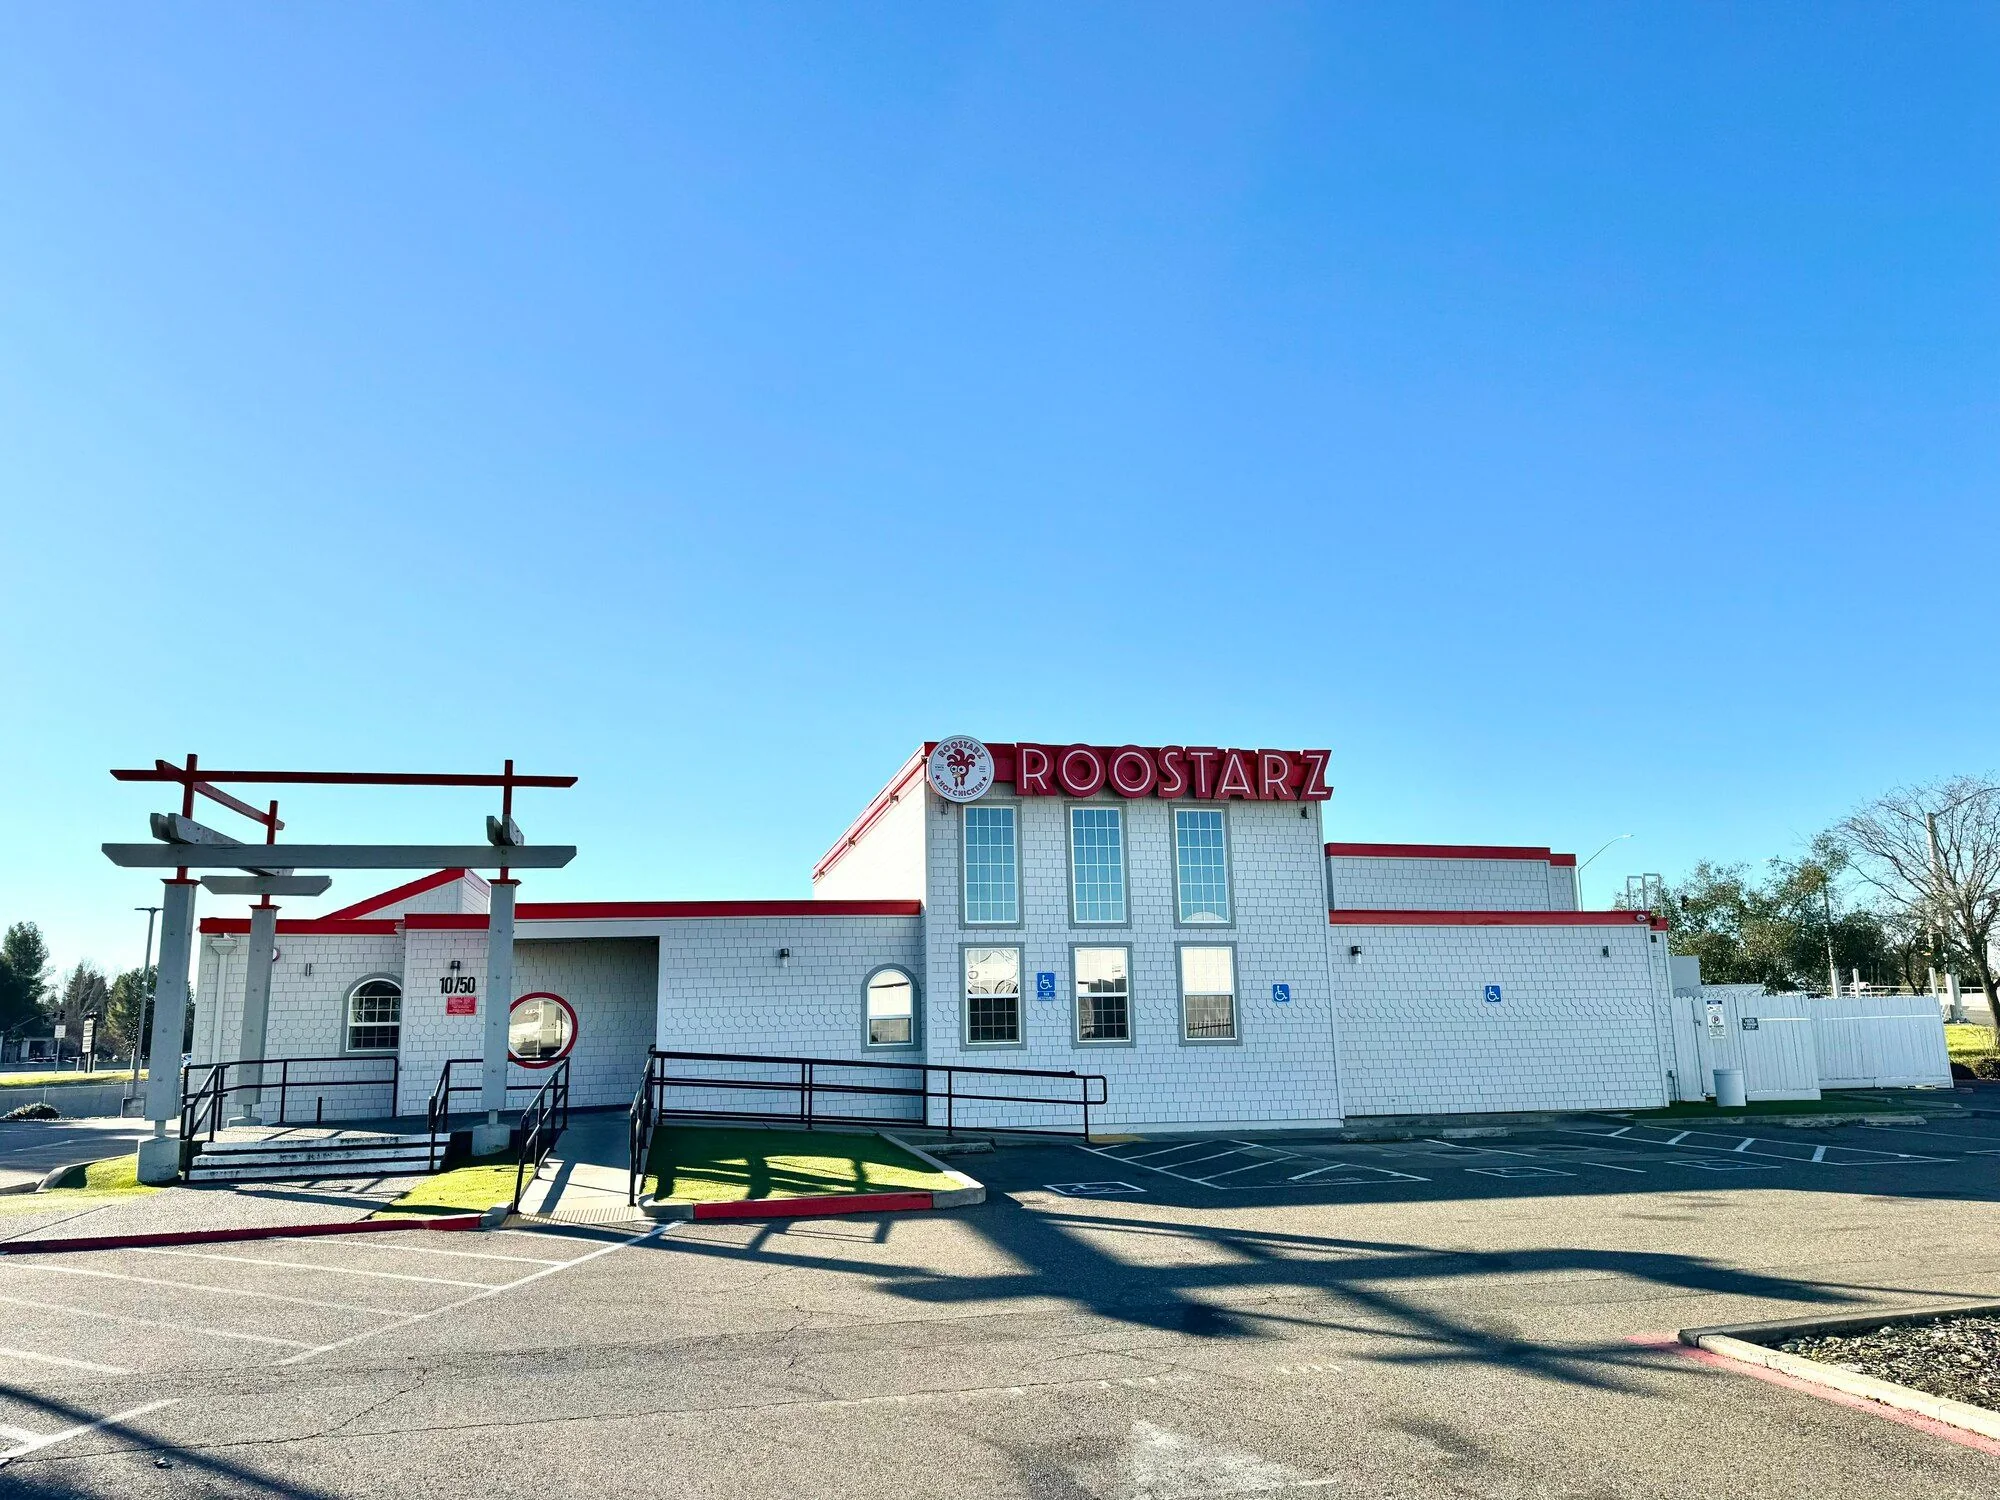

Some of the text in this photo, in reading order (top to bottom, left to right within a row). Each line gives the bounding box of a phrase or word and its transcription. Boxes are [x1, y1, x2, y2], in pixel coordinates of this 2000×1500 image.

[938, 740, 985, 759] ROOSTARZ
[1016, 743, 1334, 800] ROOSTARZ
[938, 780, 984, 796] HOT CHICKEN
